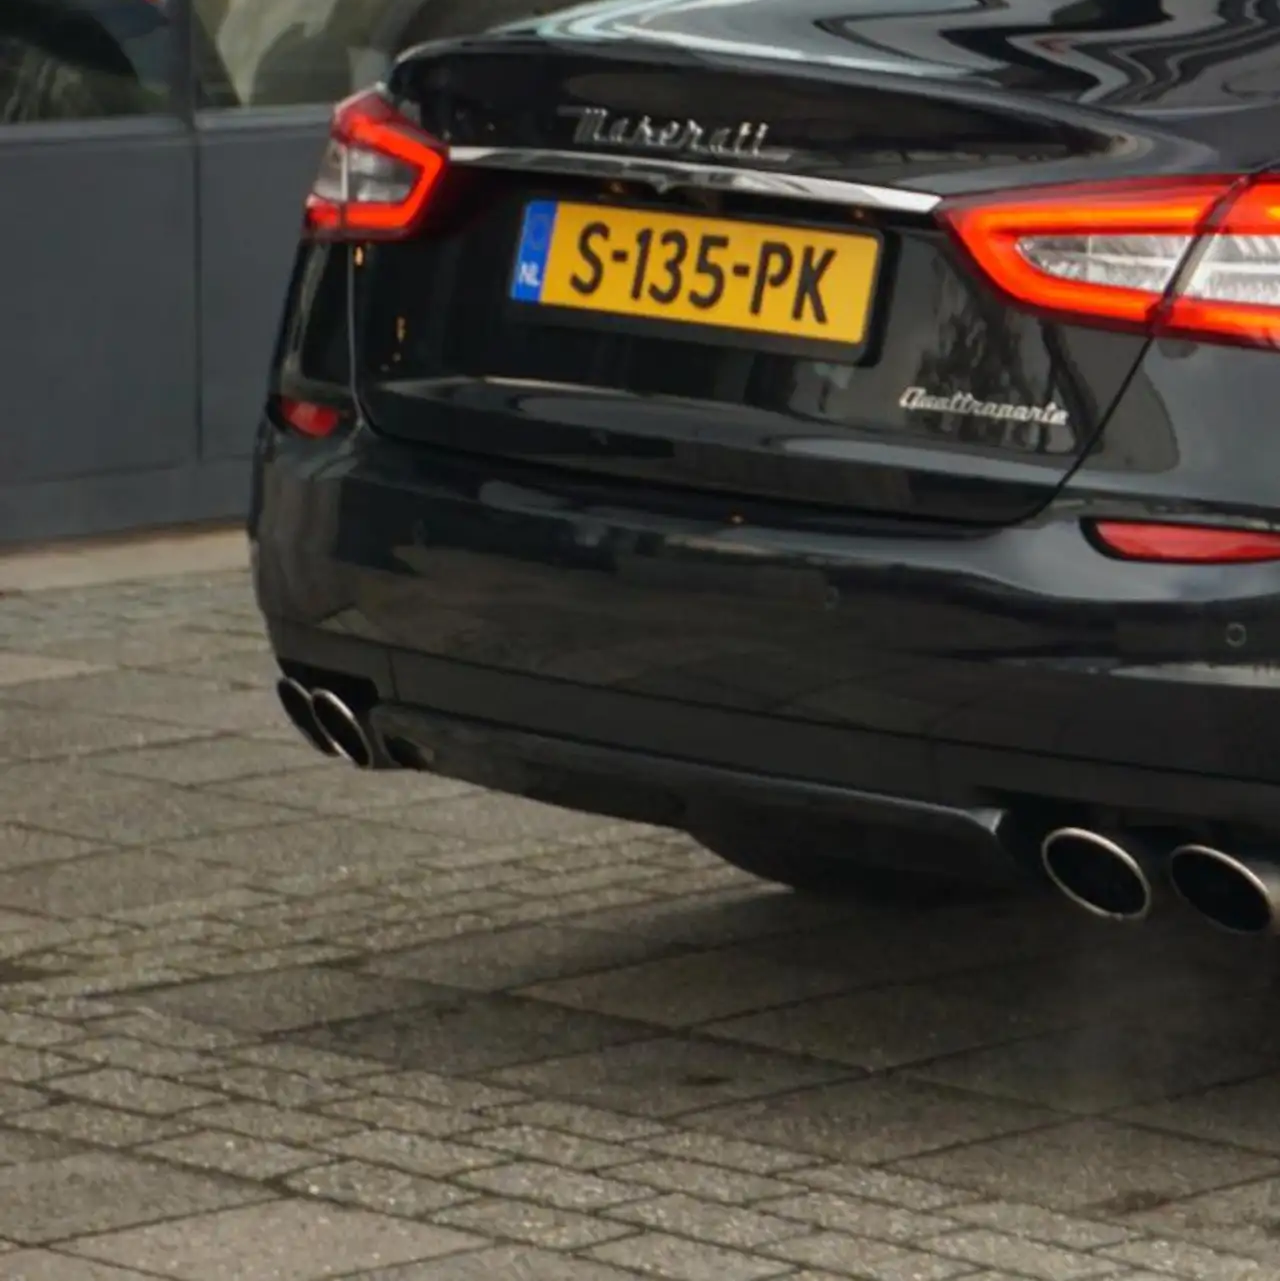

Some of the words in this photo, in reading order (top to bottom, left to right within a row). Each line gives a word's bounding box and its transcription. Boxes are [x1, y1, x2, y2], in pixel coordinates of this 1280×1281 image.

[557, 105, 792, 160] Maserati
[518, 261, 540, 287] NL
[570, 222, 836, 324] S-135-PK
[899, 385, 1070, 427] Quattroporte
